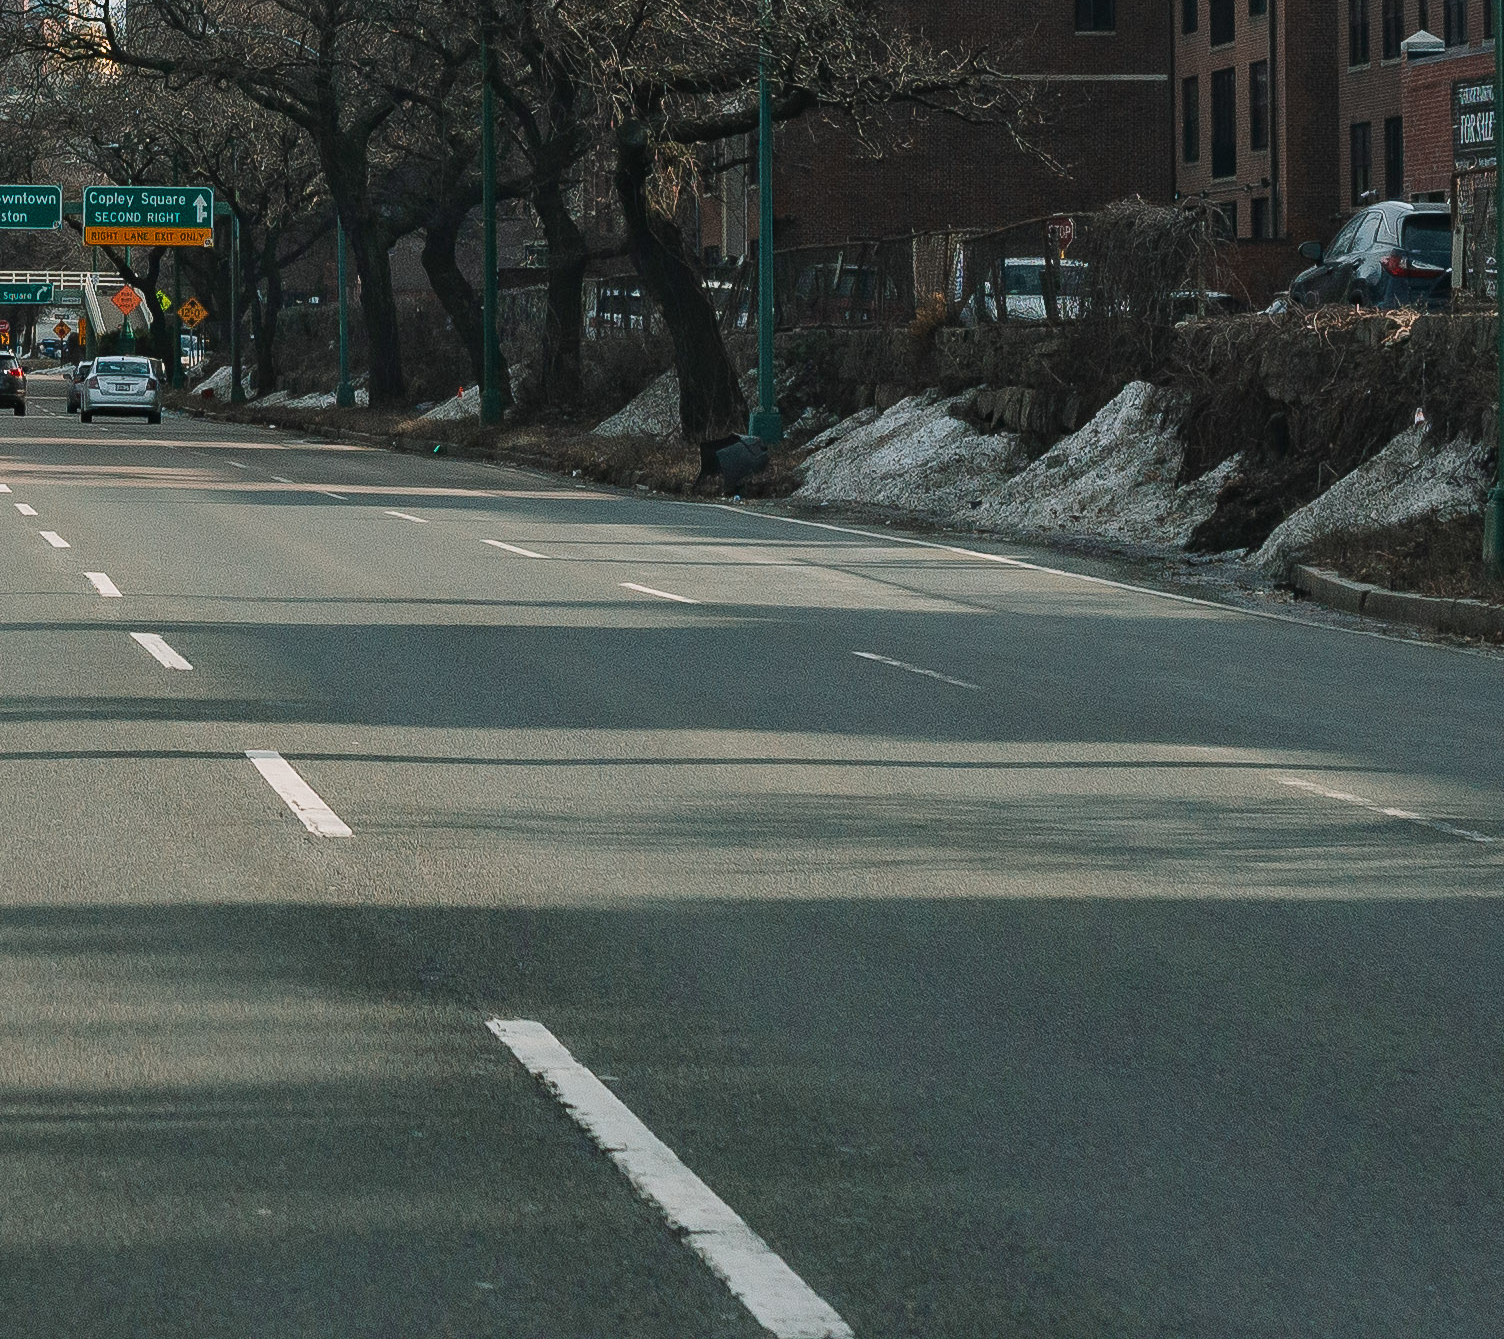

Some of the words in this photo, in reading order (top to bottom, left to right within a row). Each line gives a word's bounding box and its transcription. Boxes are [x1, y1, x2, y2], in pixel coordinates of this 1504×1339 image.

[1461, 113, 1476, 144] FOR
[89, 191, 134, 208] Copley
[141, 192, 186, 207] Square
[94, 212, 141, 223] SECOND
[147, 212, 181, 223] RIGHT
[91, 231, 118, 241] RIGHT
[123, 231, 149, 241] LANE
[154, 231, 174, 241] EXIT
[179, 231, 205, 242] ONLY
[3, 292, 32, 302] Square
